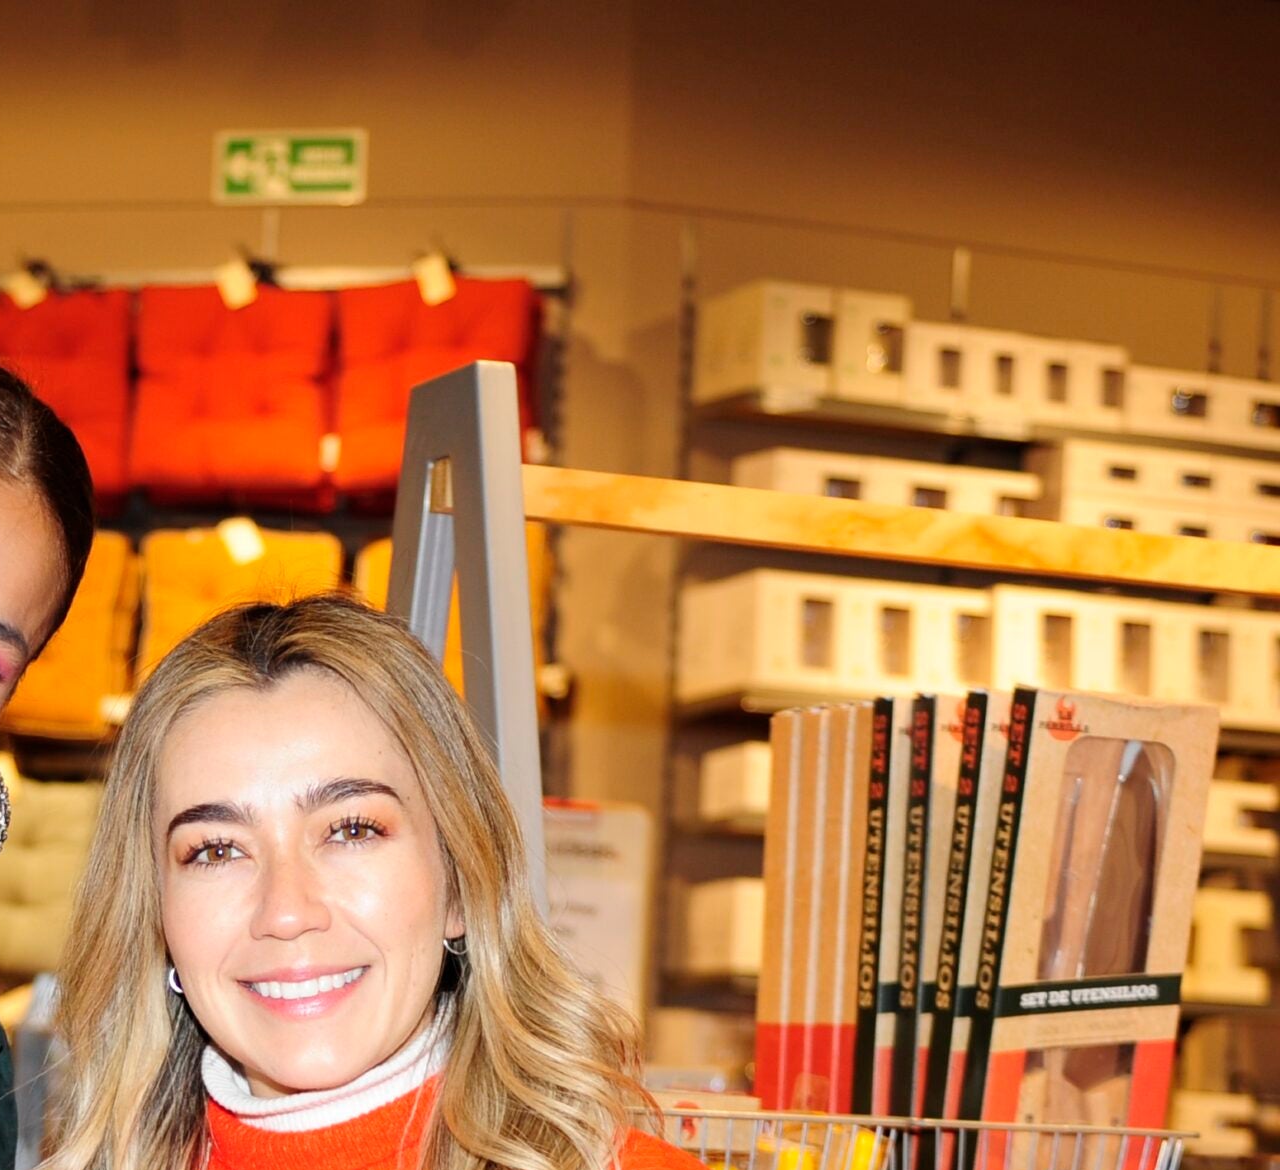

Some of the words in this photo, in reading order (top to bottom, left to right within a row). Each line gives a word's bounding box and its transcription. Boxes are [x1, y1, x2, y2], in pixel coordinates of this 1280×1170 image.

[871, 714, 887, 774] SET
[914, 711, 929, 771] SET
[963, 707, 980, 769] SET
[1009, 703, 1028, 768] SET
[870, 782, 884, 798] 2
[912, 779, 925, 797] 2
[959, 777, 972, 796] 2
[1004, 774, 1018, 793] 2
[859, 806, 883, 1008] UTENSILIOS
[899, 805, 924, 1008] UTENSILIOS
[935, 804, 970, 1009] UTENSILIOS
[975, 802, 1016, 1009] UTENSILIOS
[1020, 991, 1047, 1009] SET
[1048, 989, 1070, 1006] DE
[1071, 984, 1159, 1004] UTENSILIOS
